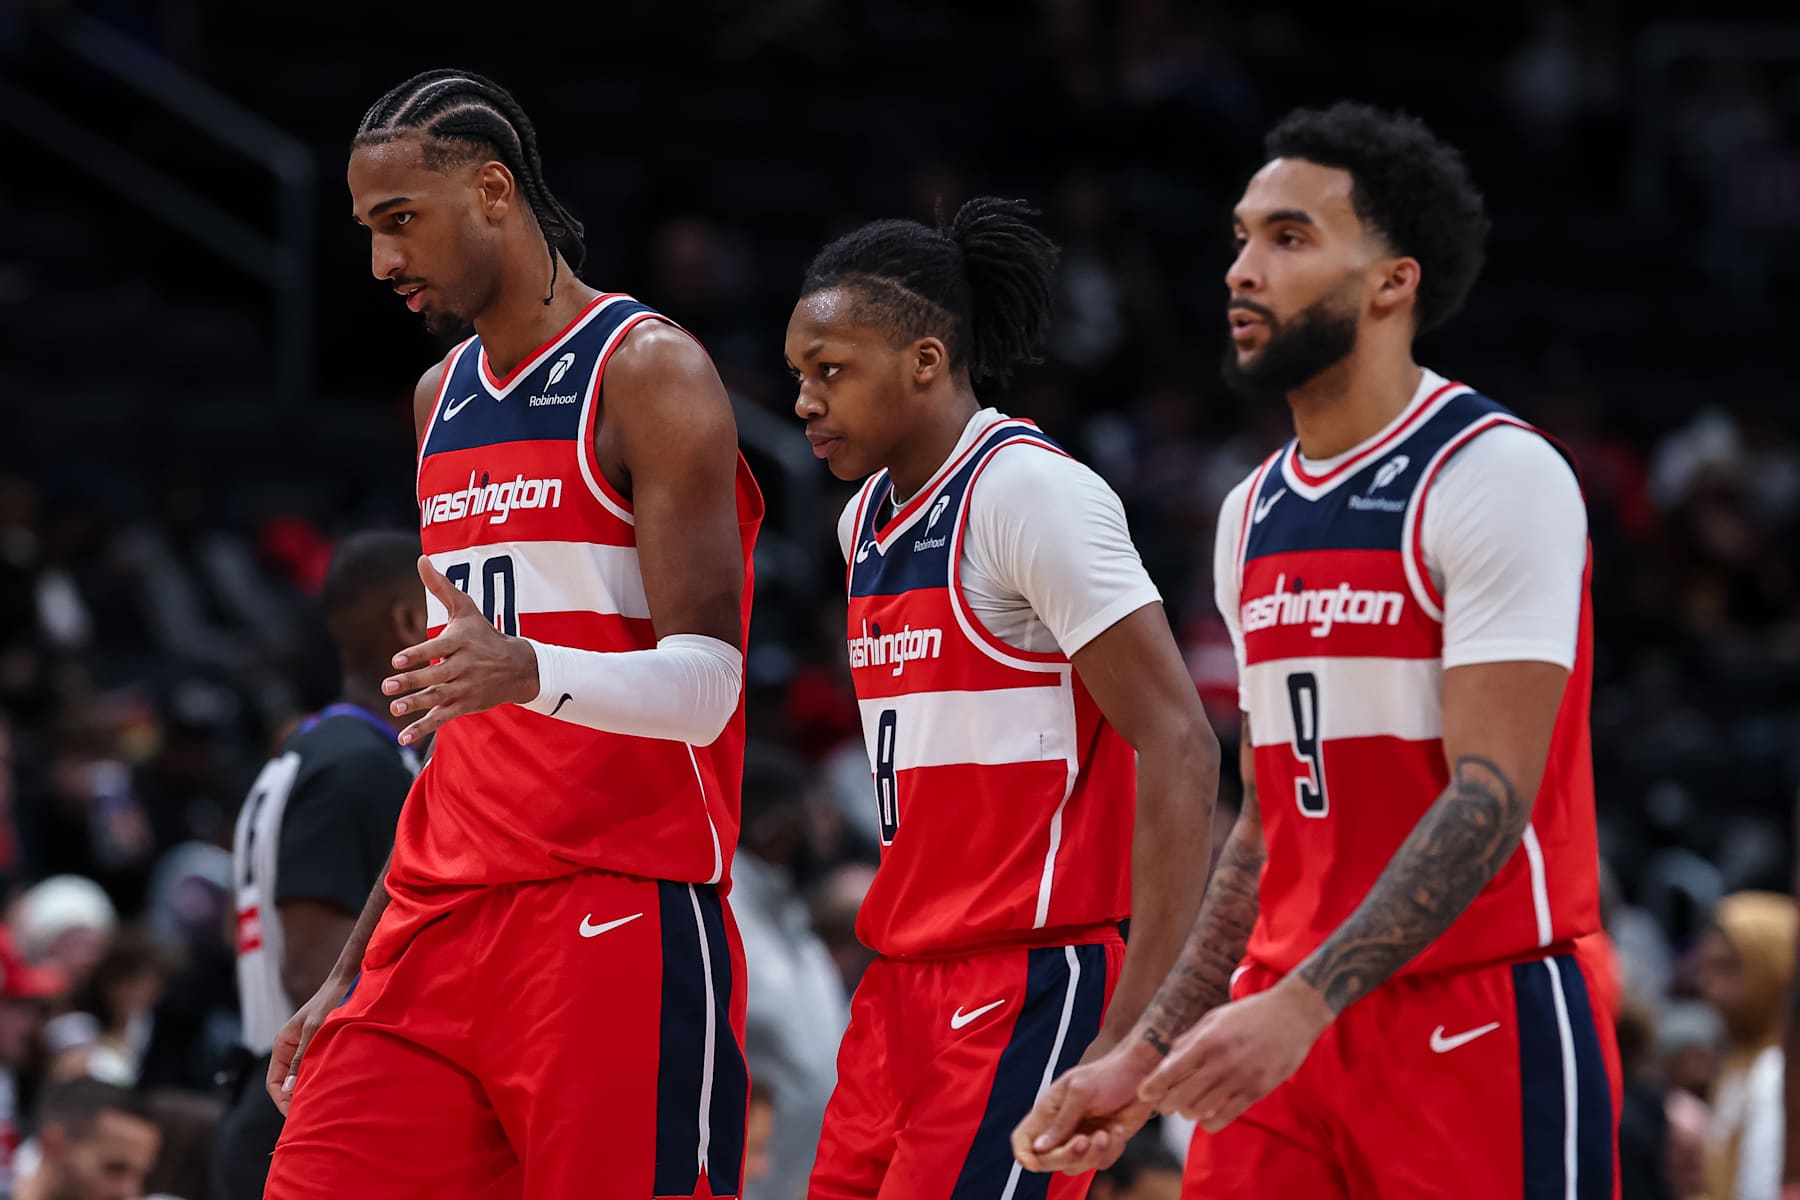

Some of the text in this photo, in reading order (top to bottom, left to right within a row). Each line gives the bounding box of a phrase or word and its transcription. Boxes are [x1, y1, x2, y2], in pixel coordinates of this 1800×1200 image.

[529, 392, 577, 407] Robinhood
[421, 470, 562, 528] washington
[445, 554, 518, 637] 0
[1242, 573, 1405, 638] ashington
[848, 618, 943, 677] ashington
[876, 708, 900, 846] 8
[1287, 672, 1329, 818] 9
